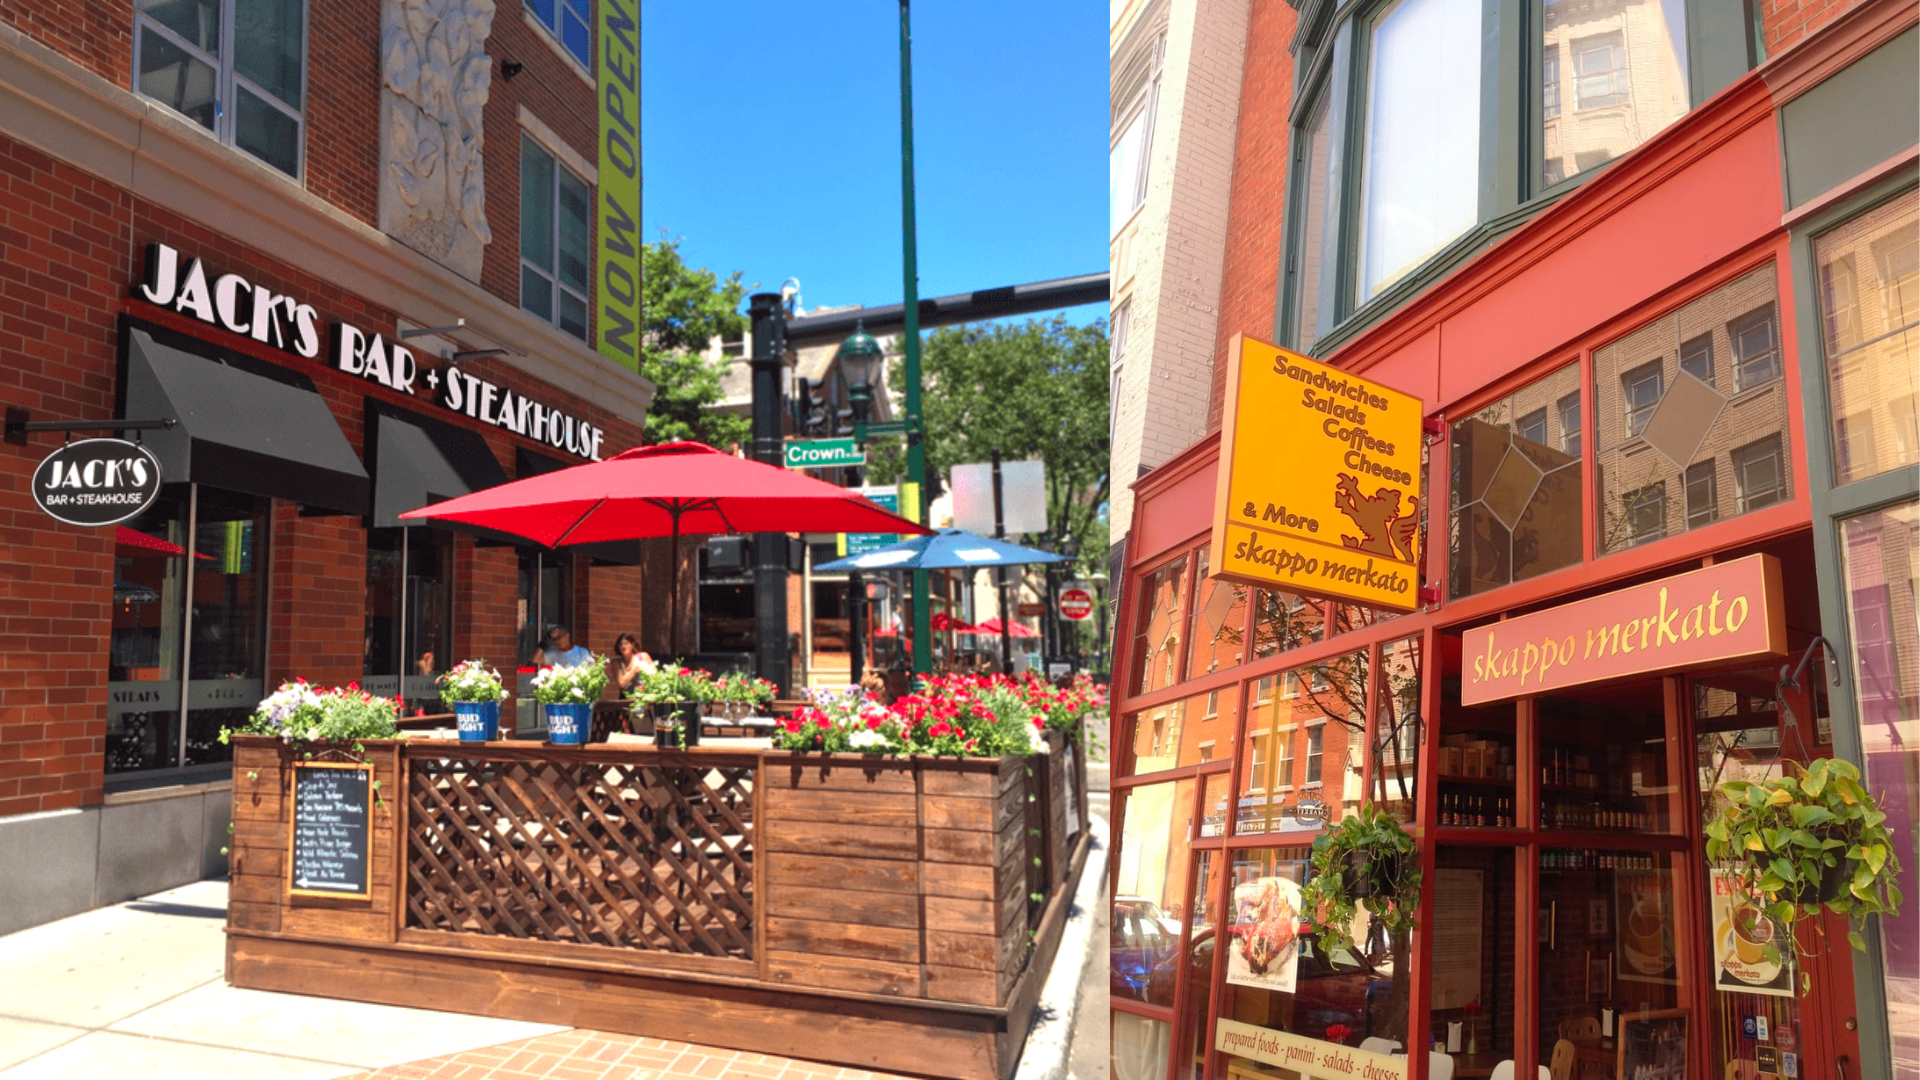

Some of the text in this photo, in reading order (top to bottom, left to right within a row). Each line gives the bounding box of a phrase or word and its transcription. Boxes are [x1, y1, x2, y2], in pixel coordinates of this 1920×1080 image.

[604, 191, 636, 357] NOW
[139, 242, 319, 359] JACK'S
[339, 321, 416, 395] BAR
[444, 366, 604, 462] STEAKHOUSE
[1273, 355, 1388, 412] Sandwiches
[1301, 388, 1366, 426] Salads
[788, 446, 846, 463] Crown
[1322, 418, 1396, 457] Coffees
[45, 457, 148, 489] JACK'S
[1344, 450, 1412, 487] Cheese
[46, 494, 68, 505] BAR
[76, 492, 143, 505] STEAKHOUSE
[1242, 501, 1319, 533] & More
[1234, 532, 1409, 594] skappo merkato
[1472, 585, 1749, 687] skappo merkato
[1223, 1031, 1258, 1051] prepared
[1257, 1032, 1280, 1055] foods
[1285, 1044, 1316, 1064] panini
[1322, 1051, 1354, 1074] salads
[1362, 1058, 1400, 1080] cheeses
